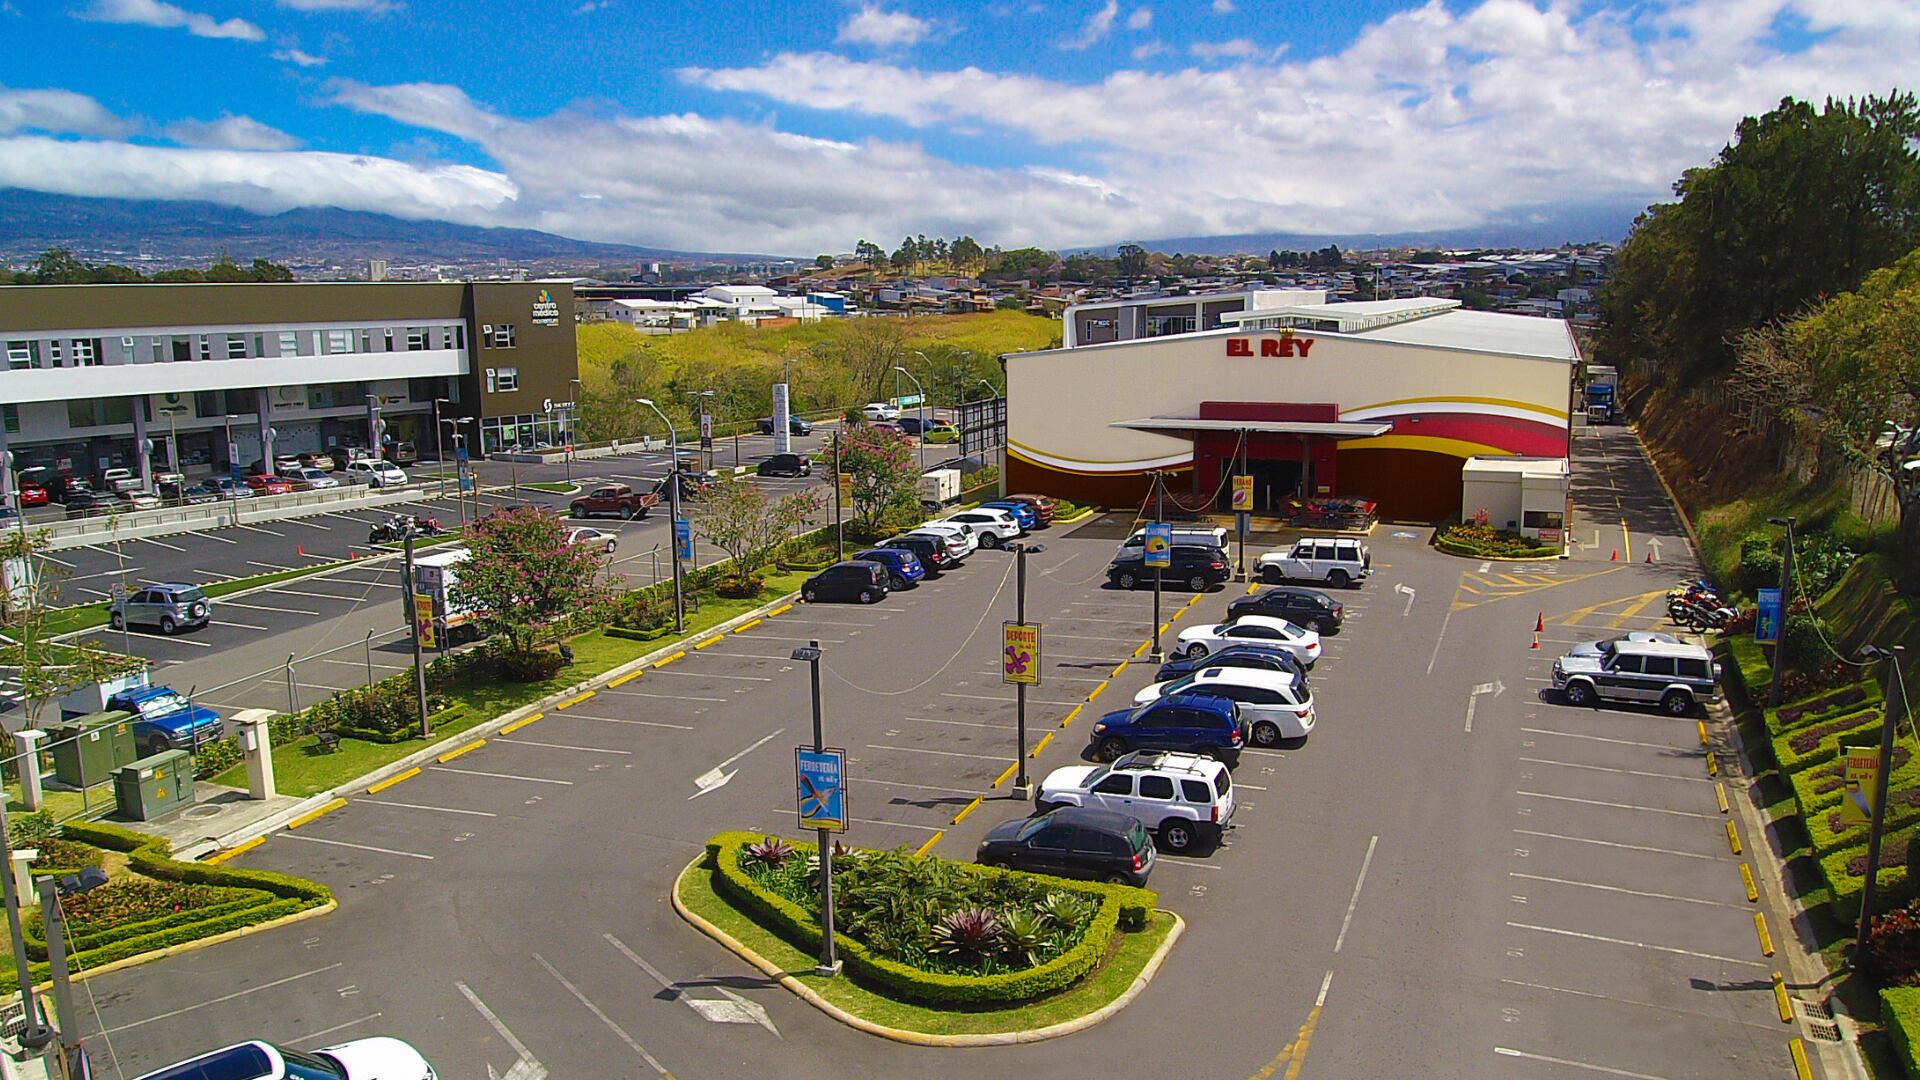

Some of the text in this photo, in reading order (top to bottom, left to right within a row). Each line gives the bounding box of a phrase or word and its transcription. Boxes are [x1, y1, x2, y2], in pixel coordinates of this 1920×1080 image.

[1227, 339, 1314, 358] EL REY
[1007, 630, 1036, 642] DEPORTE
